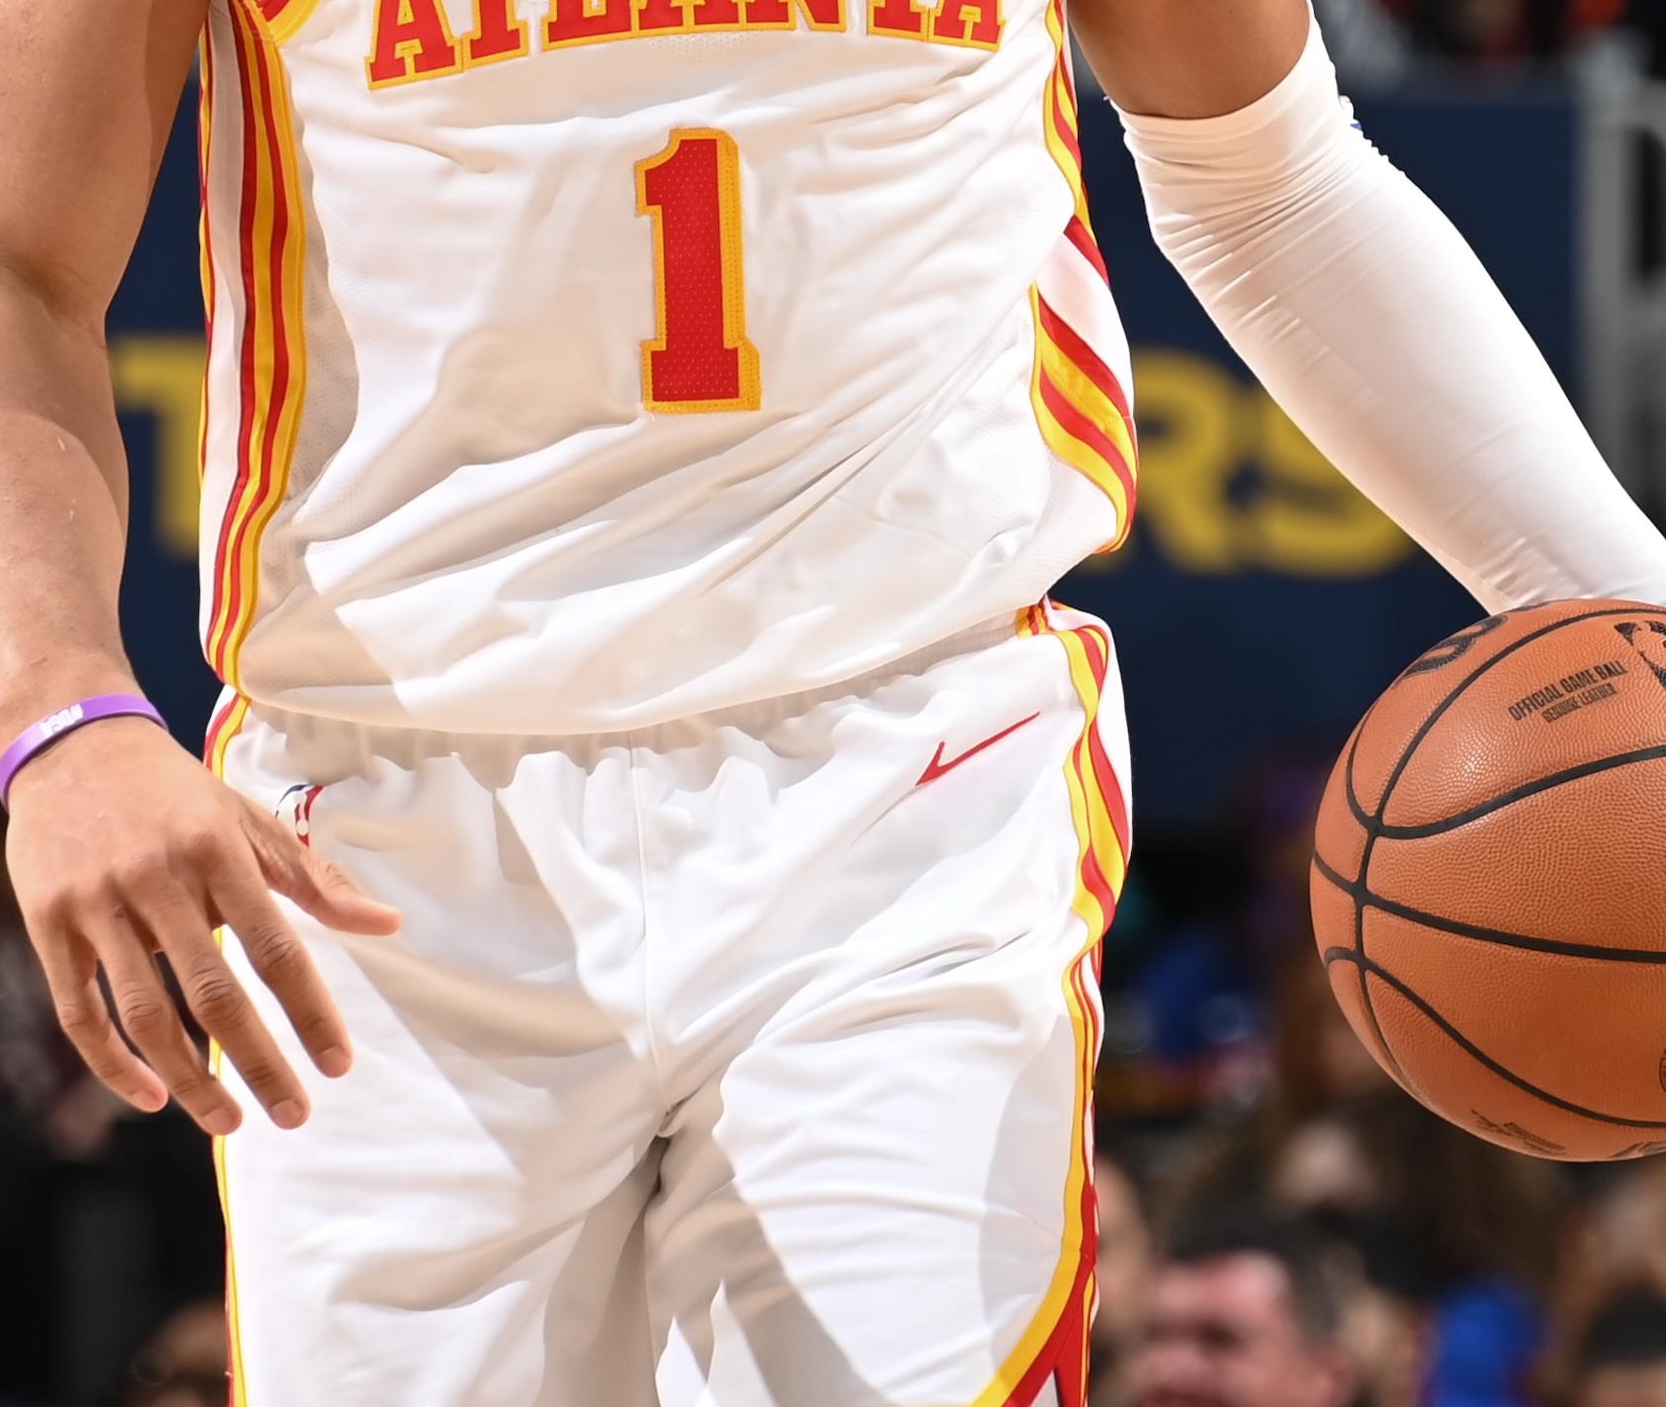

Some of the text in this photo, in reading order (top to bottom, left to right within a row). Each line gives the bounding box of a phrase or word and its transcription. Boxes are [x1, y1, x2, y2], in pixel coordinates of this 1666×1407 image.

[634, 127, 762, 413] 1
[1508, 660, 1629, 721] OFFICIAL GAME BALL
[1577, 682, 1618, 706] LEATHER
